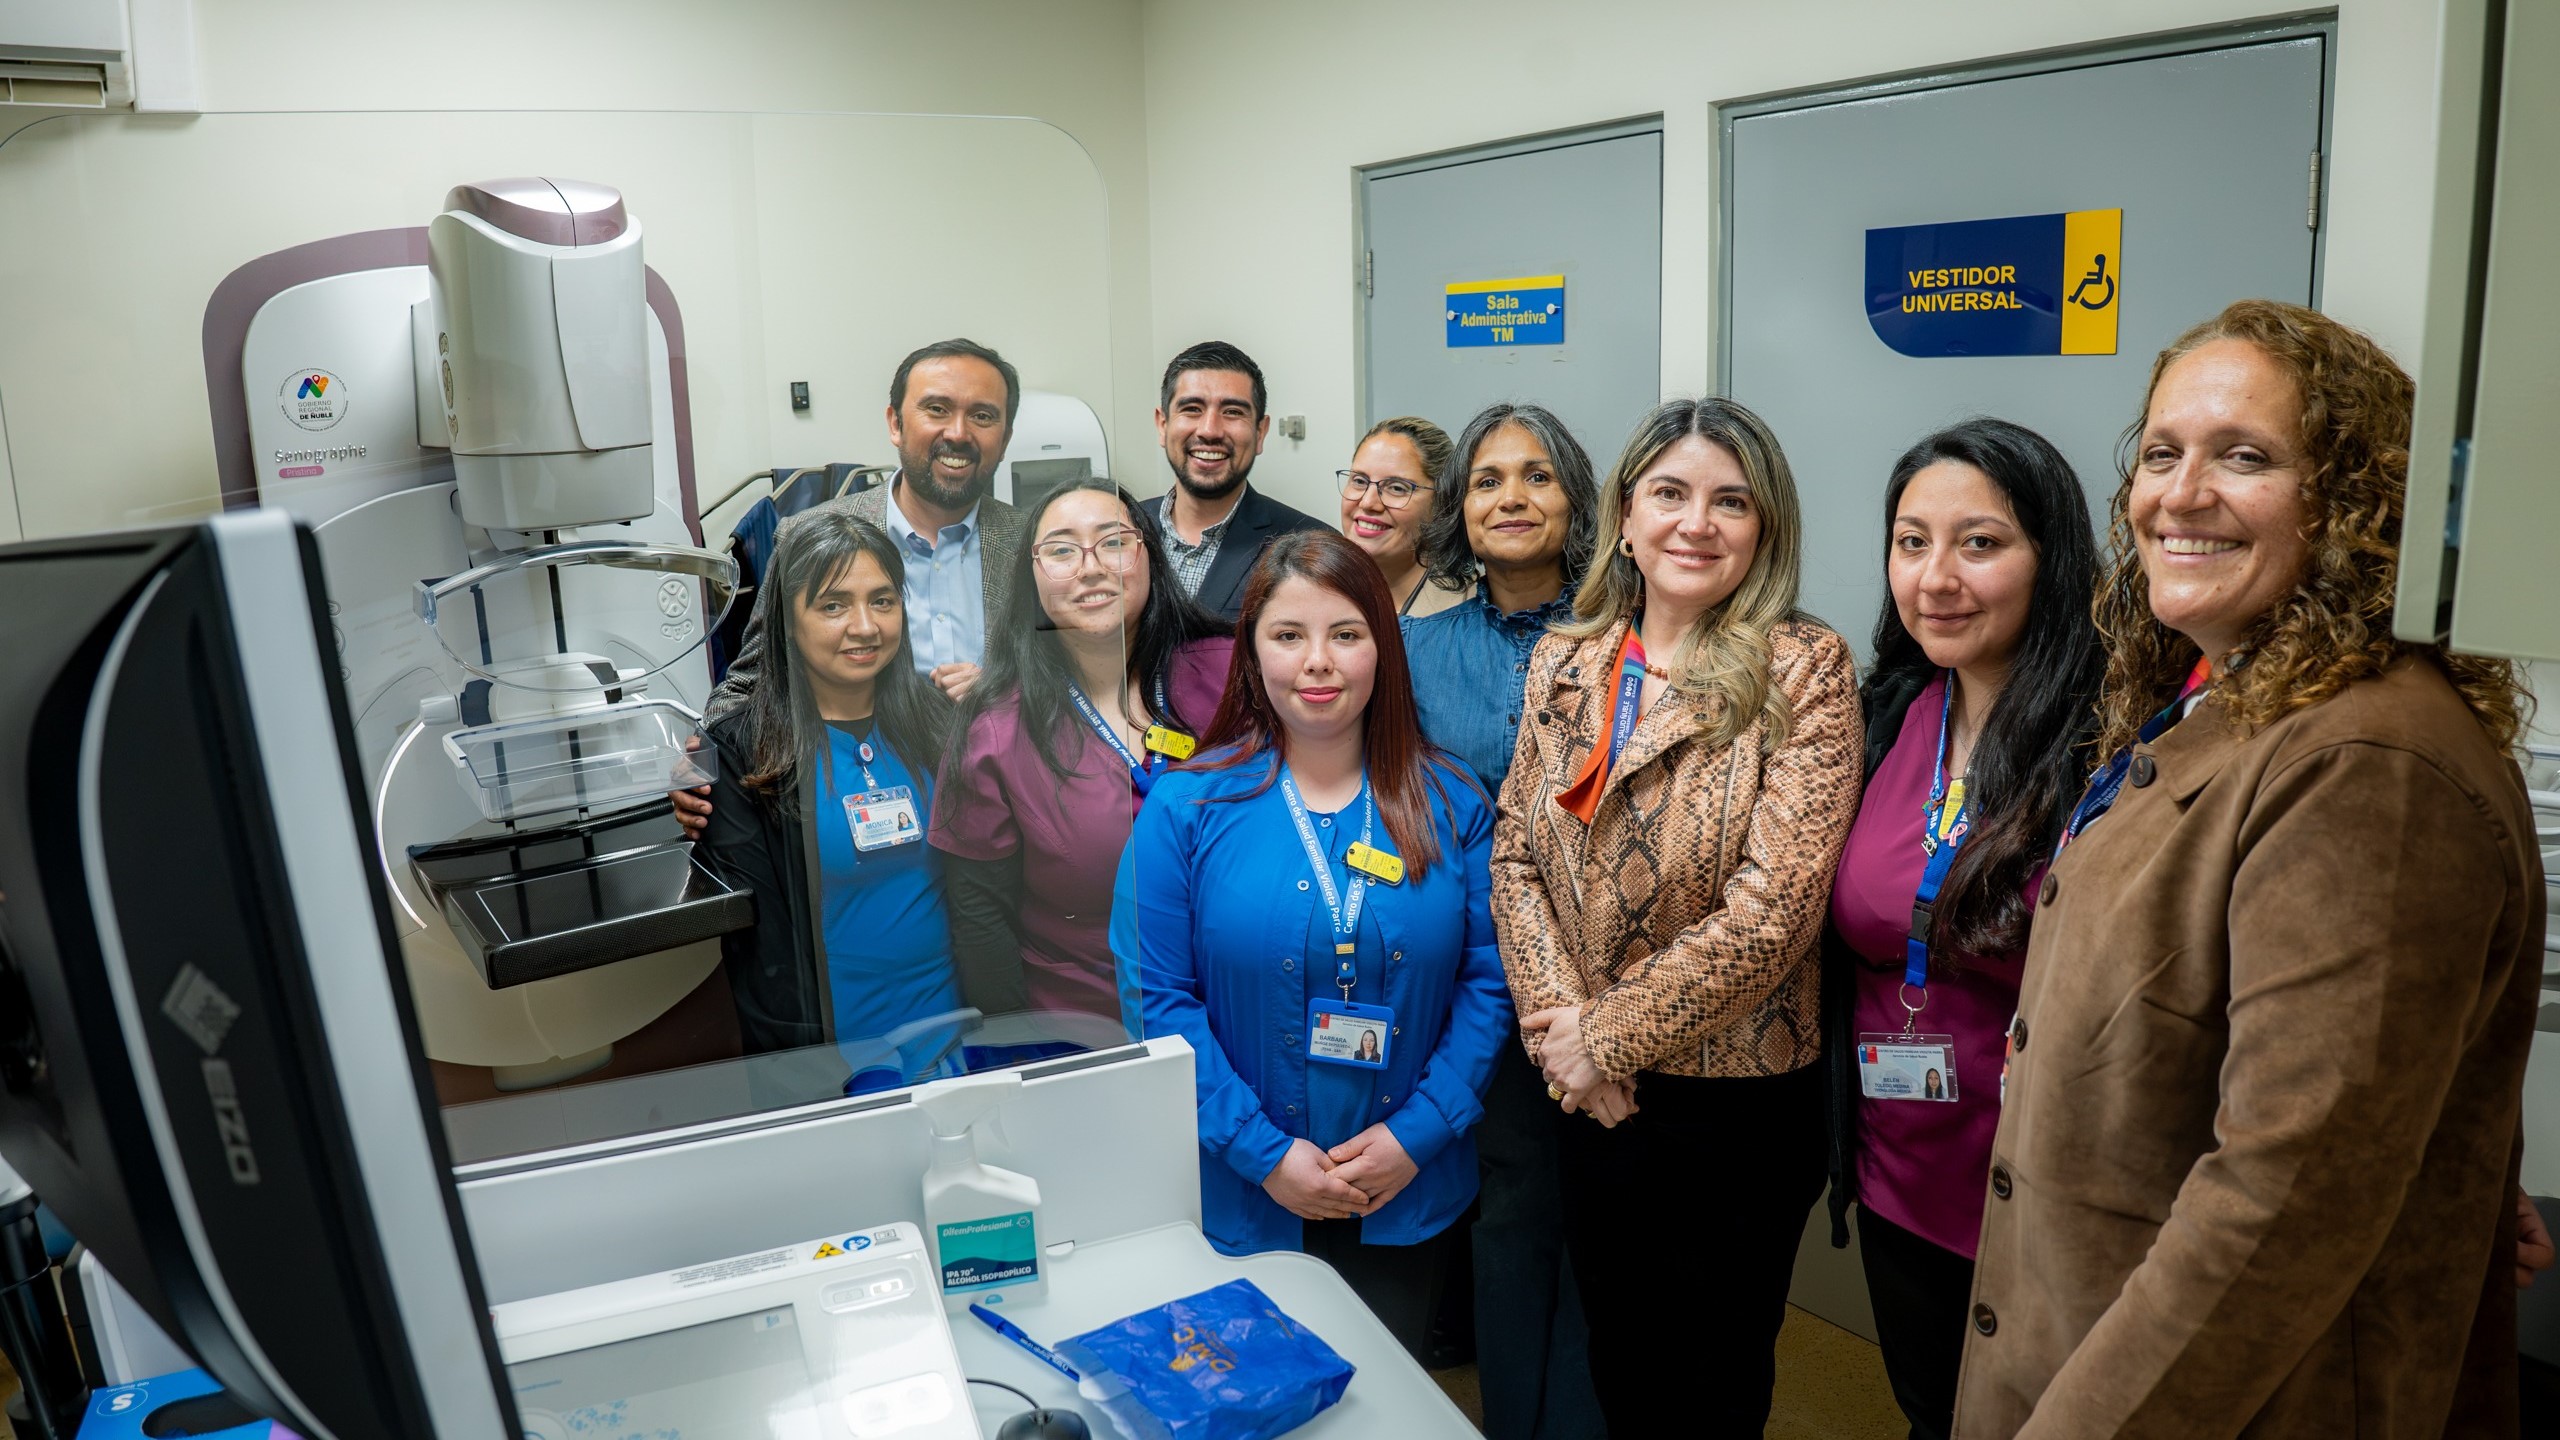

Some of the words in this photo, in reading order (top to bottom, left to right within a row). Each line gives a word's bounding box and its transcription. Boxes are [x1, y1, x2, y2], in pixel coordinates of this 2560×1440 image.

[1908, 265, 2016, 289] VESTIDOR
[1487, 294, 1519, 310] Sala
[1902, 291, 2022, 313] UNIVERSAL
[1460, 310, 1547, 327] Administrativa
[1491, 327, 1514, 342] TM
[298, 400, 332, 408] GOBIERNO
[310, 412, 334, 420] ÑUBLE
[275, 442, 368, 464] Senographe
[286, 467, 318, 477] Pristina
[1619, 700, 1630, 718] ÑUBLE
[1075, 695, 1101, 727] FAMILIAR
[1098, 724, 1121, 750] VIOLETA
[1119, 747, 1137, 769] PARRA
[1617, 718, 1627, 738] SALUD
[865, 818, 893, 831] MONICA
[1364, 801, 1373, 829] Violeta
[1282, 779, 1296, 807] Centro
[1292, 806, 1301, 818] de
[1297, 816, 1311, 840] Salud
[1306, 837, 1324, 876] Familiar
[1320, 874, 1335, 906] Violeta
[1330, 907, 1341, 933] Parra
[1352, 870, 1366, 889] Salu
[1351, 890, 1361, 902] de
[1343, 902, 1357, 934] Centro
[1319, 1034, 1347, 1044] BARBARA
[202, 1058, 261, 1186] EIZO
[942, 1218, 1013, 1237] DifemProfesional
[946, 1269, 961, 1278] IPA
[947, 1275, 981, 1286] ALCOHOL
[981, 1265, 1031, 1281] ISOPROPÍLICO
